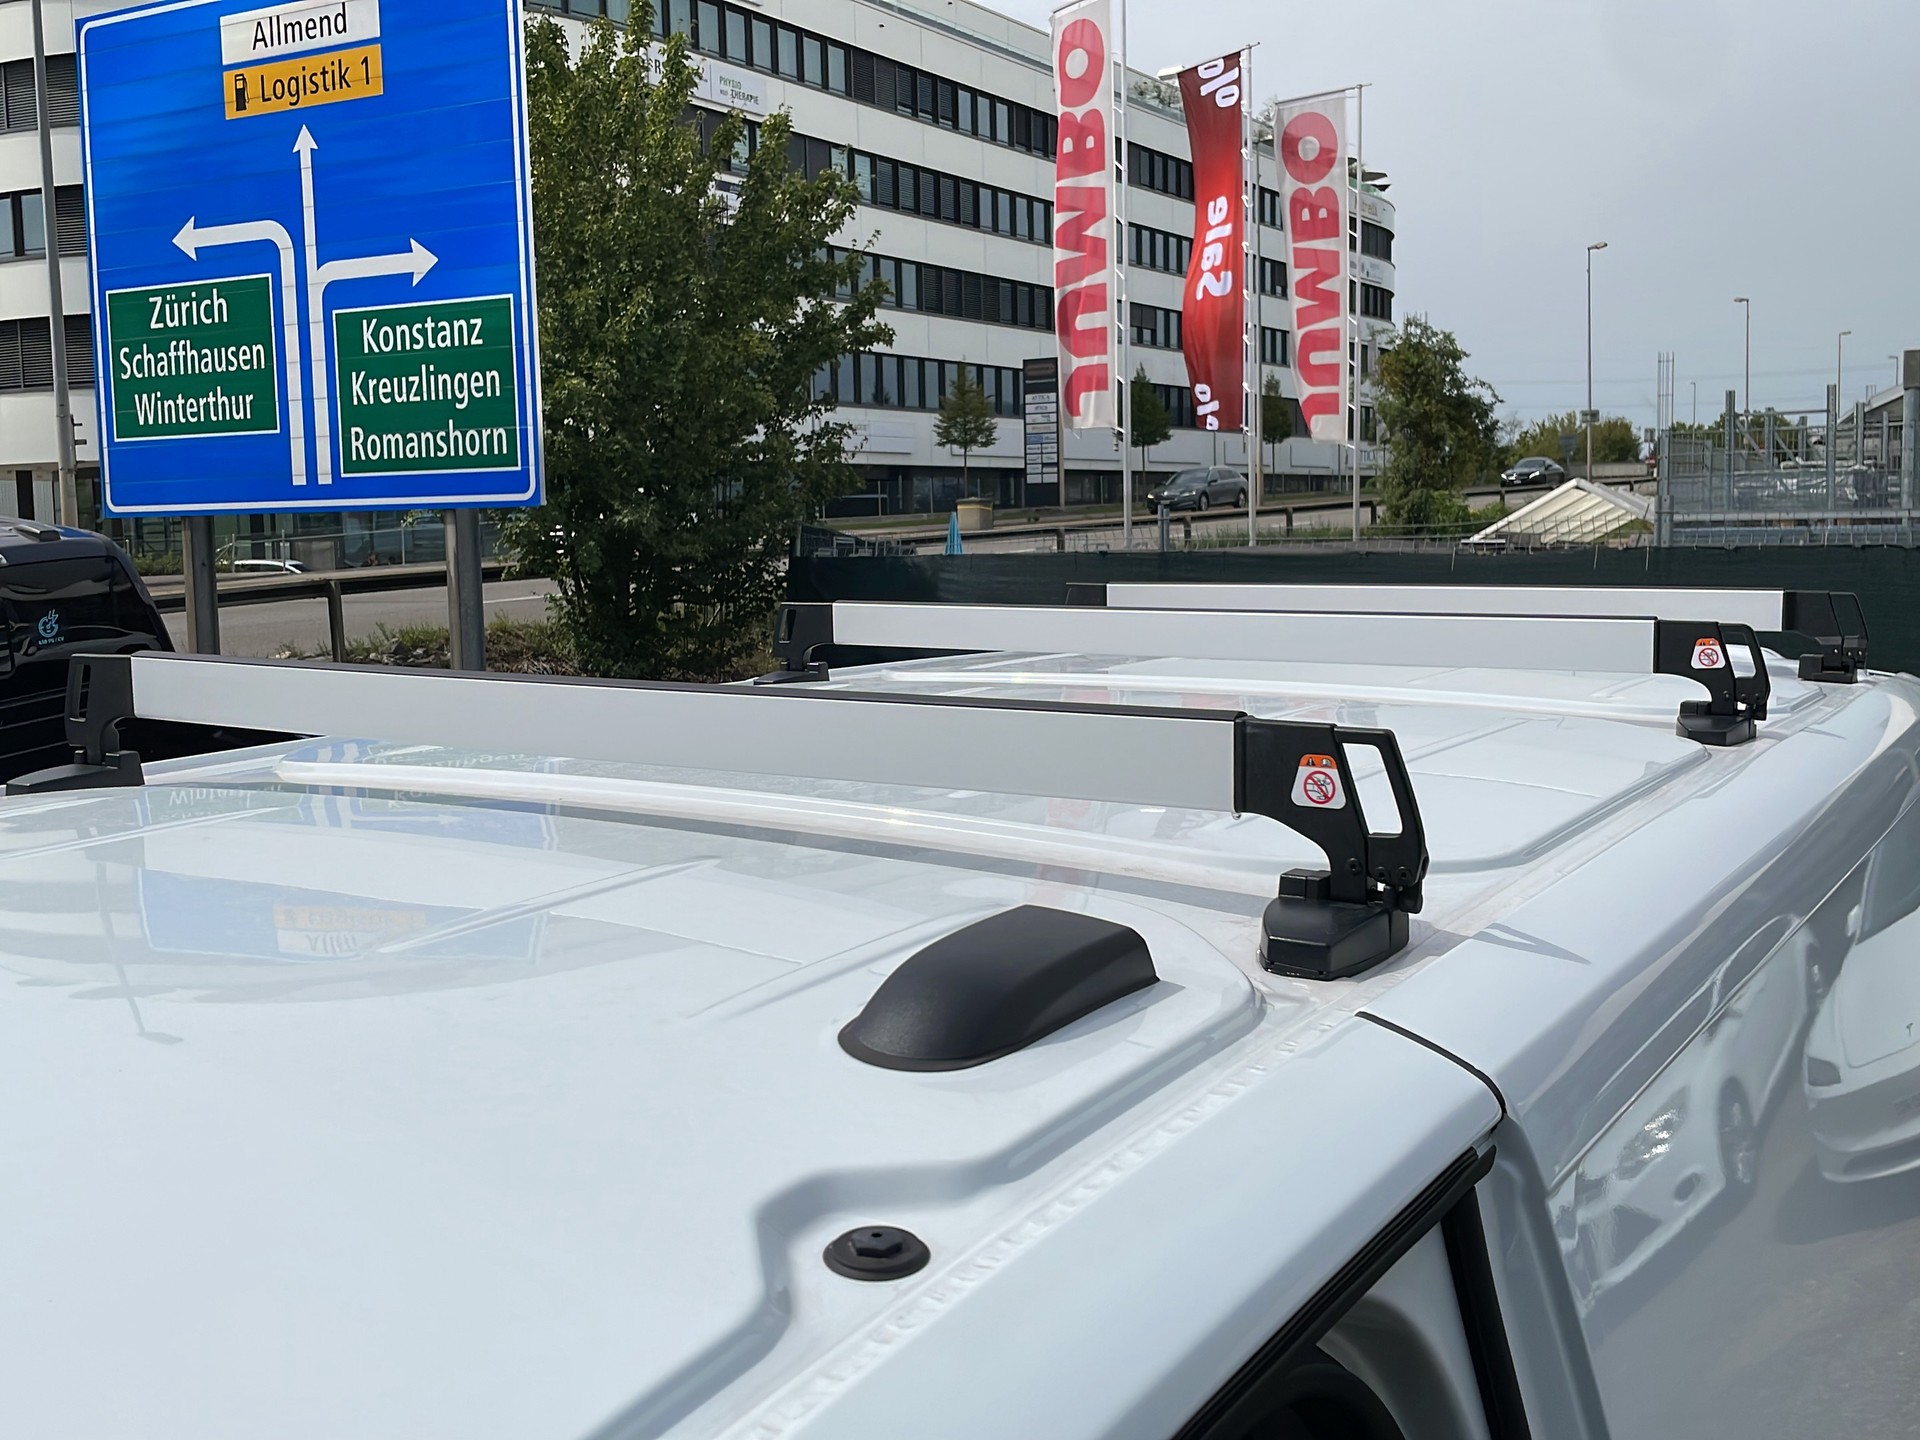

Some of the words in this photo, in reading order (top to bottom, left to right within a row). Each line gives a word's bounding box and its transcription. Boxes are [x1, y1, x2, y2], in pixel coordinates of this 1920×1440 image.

[252, 1, 347, 51] Allmend
[260, 58, 351, 106] Logistik
[360, 55, 370, 85] 1
[149, 288, 228, 330] Zürich
[362, 316, 483, 354] Konstanz
[119, 339, 266, 380] Schaffhausen
[134, 385, 254, 426] Winterthur
[351, 364, 501, 410] Kreuzlingen
[350, 418, 508, 461] Romanshorn
